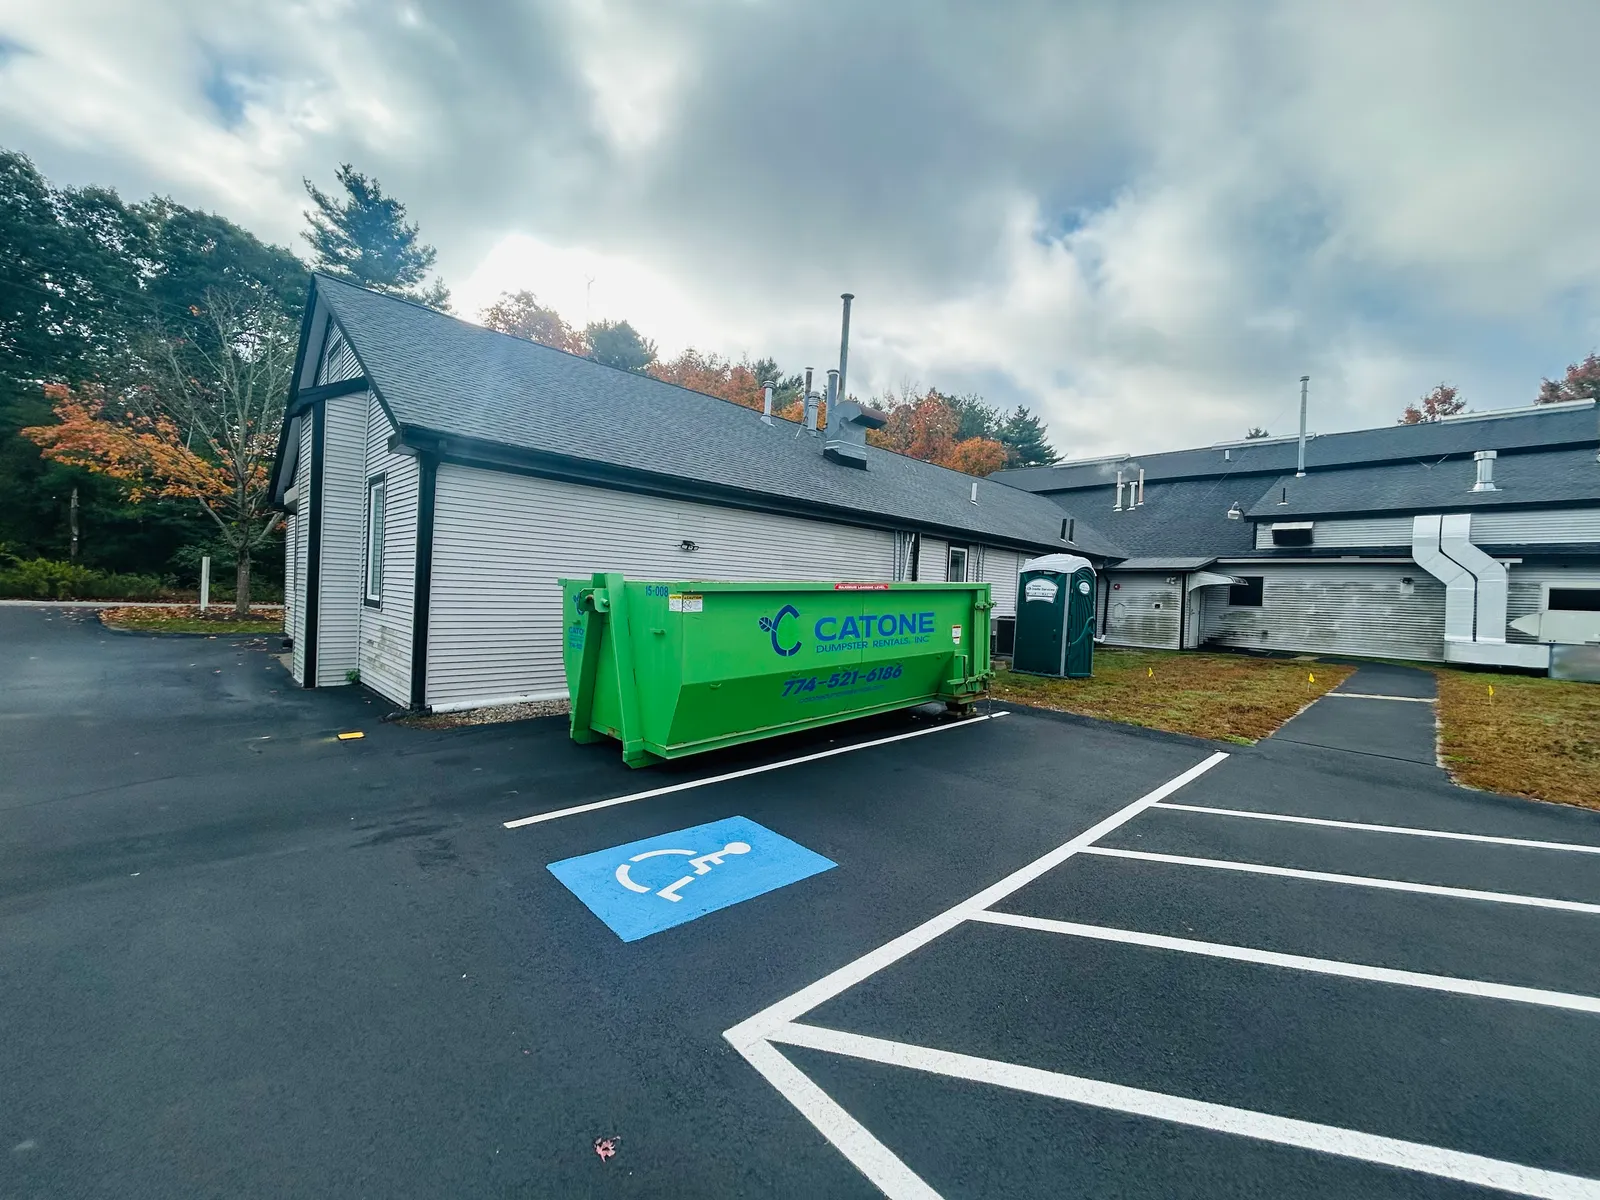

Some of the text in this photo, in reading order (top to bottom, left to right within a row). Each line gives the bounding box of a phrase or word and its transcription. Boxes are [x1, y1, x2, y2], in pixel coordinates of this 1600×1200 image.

[645, 585, 669, 597] 15-008
[568, 626, 585, 635] CATO
[814, 612, 935, 642] CATONE
[816, 641, 868, 654] DUMPSTER
[782, 664, 903, 696] 774-521-6186
